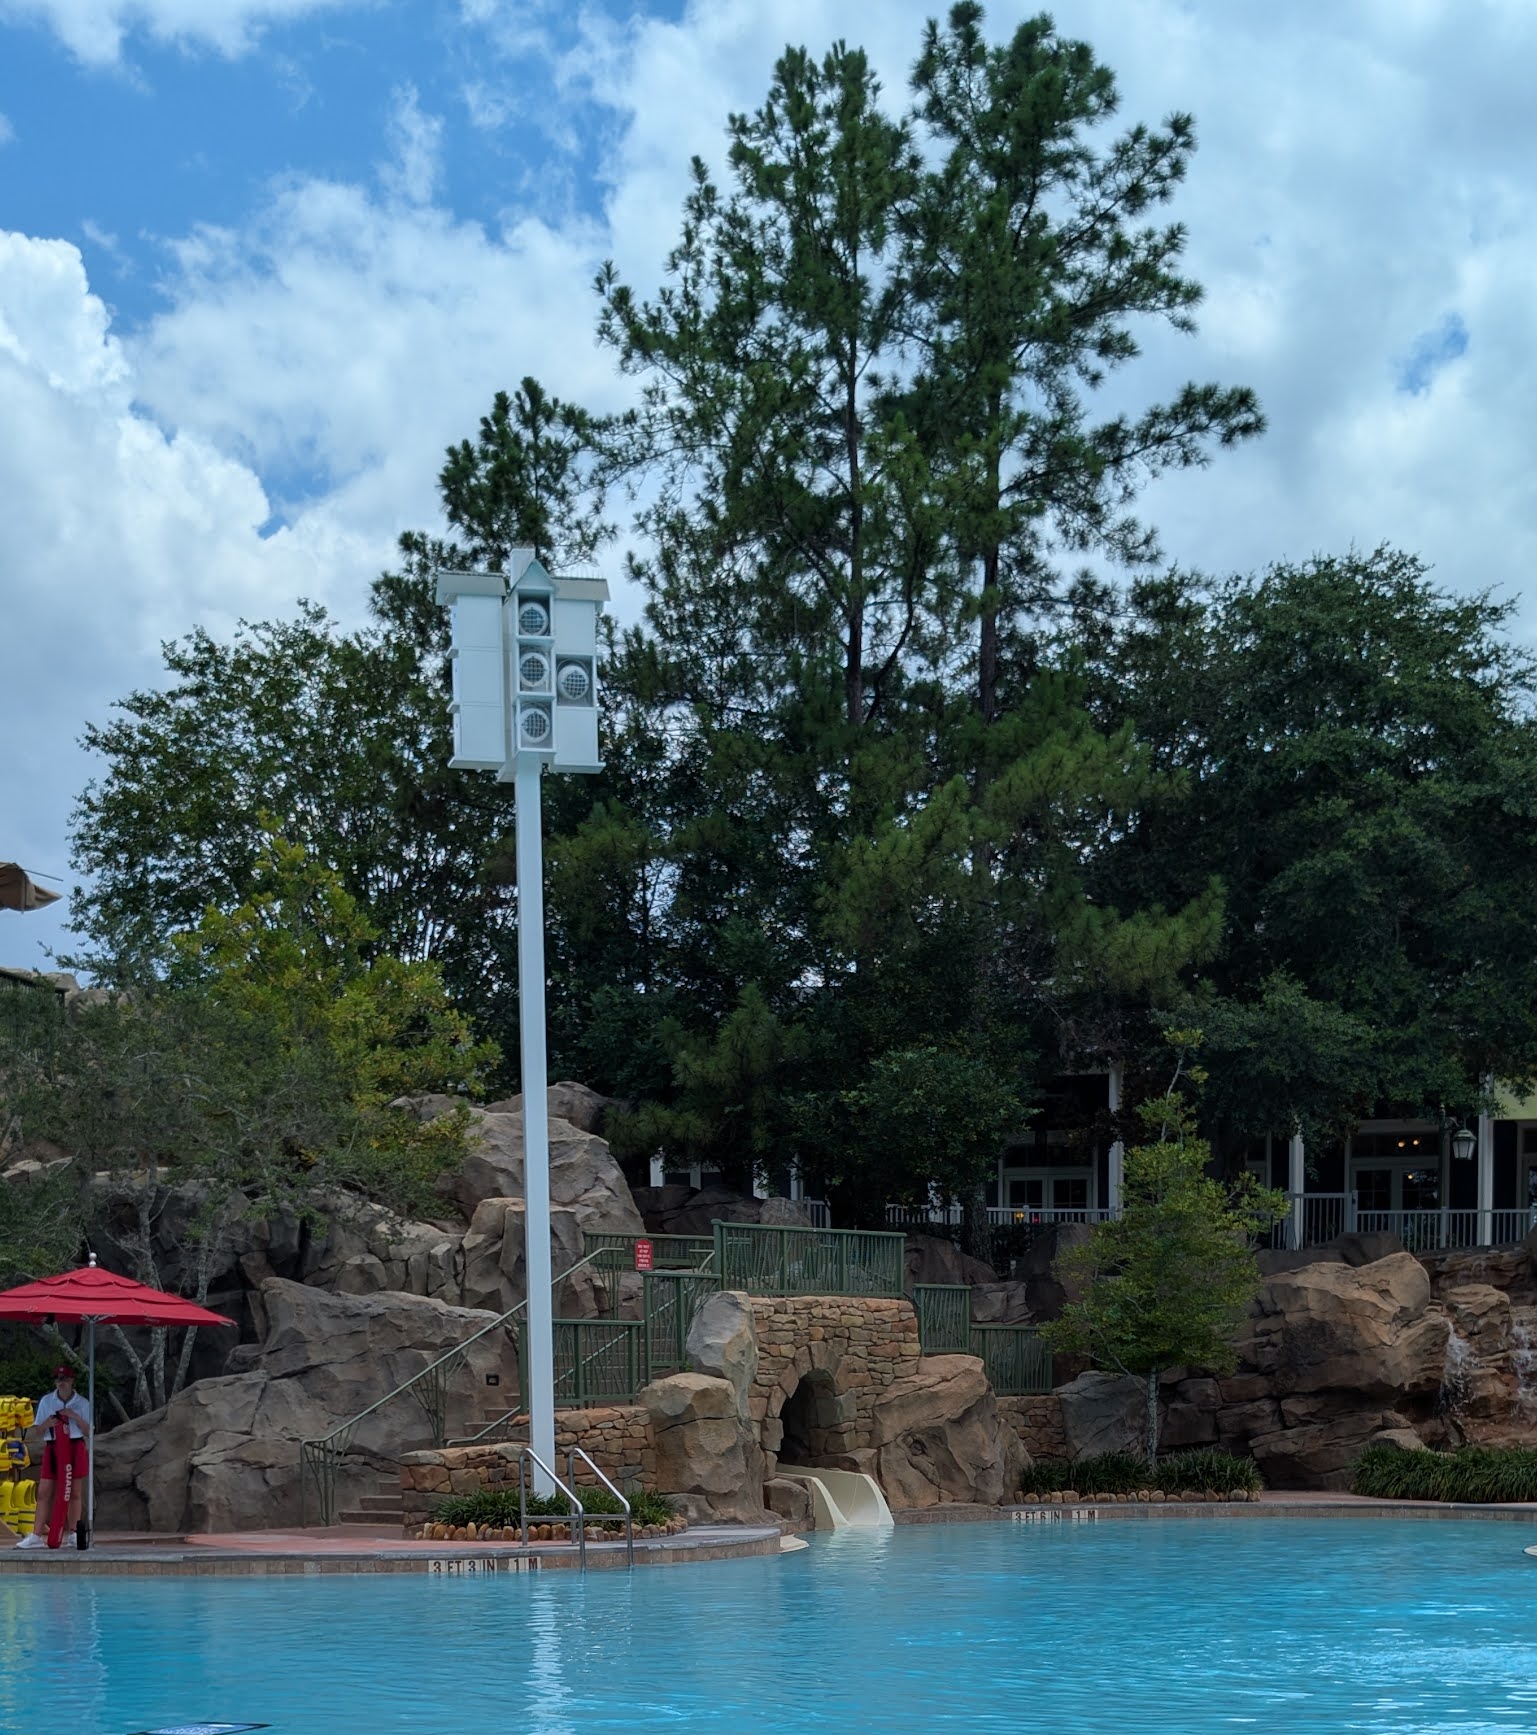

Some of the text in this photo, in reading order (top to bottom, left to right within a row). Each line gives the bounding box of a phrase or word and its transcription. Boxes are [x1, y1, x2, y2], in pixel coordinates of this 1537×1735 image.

[64, 1463, 73, 1502] GUARD
[433, 1561, 442, 1572] 3
[447, 1560, 462, 1572] FT
[468, 1560, 476, 1572] 3
[528, 1557, 538, 1570] M
